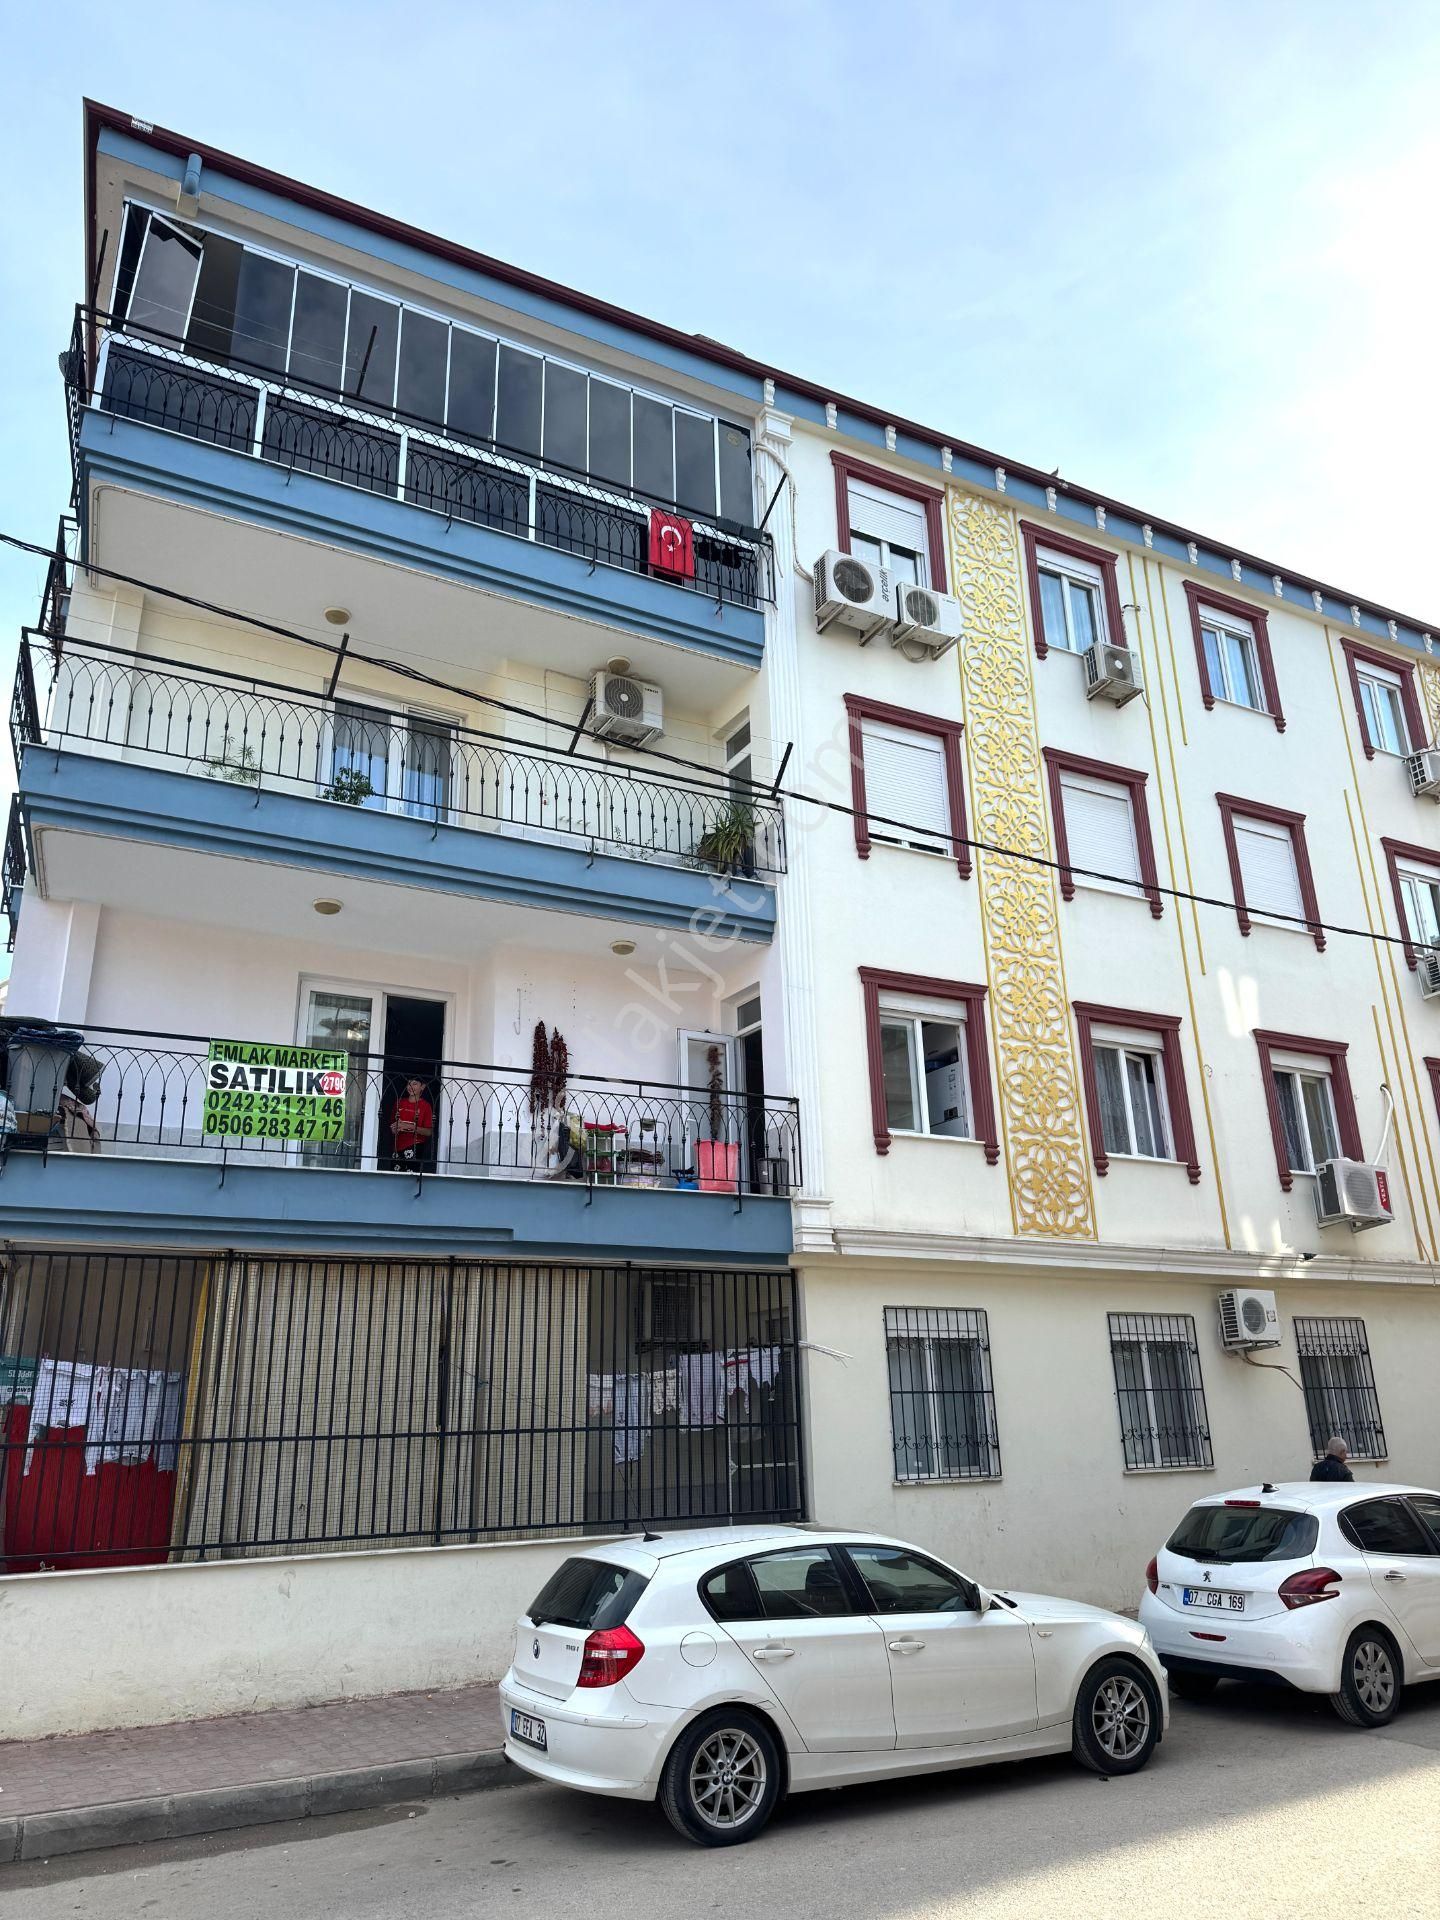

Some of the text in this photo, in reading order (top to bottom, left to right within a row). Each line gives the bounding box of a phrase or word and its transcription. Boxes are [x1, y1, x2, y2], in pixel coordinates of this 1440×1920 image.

[213, 1044, 272, 1066] EMLAK
[209, 1063, 325, 1095] SATILIK
[322, 1075, 346, 1092] 2790
[208, 1091, 343, 1118] 0242 321 21 46
[206, 1113, 343, 1140] 0506 283 47 17
[1188, 1590, 1243, 1609] 07 CGA 169
